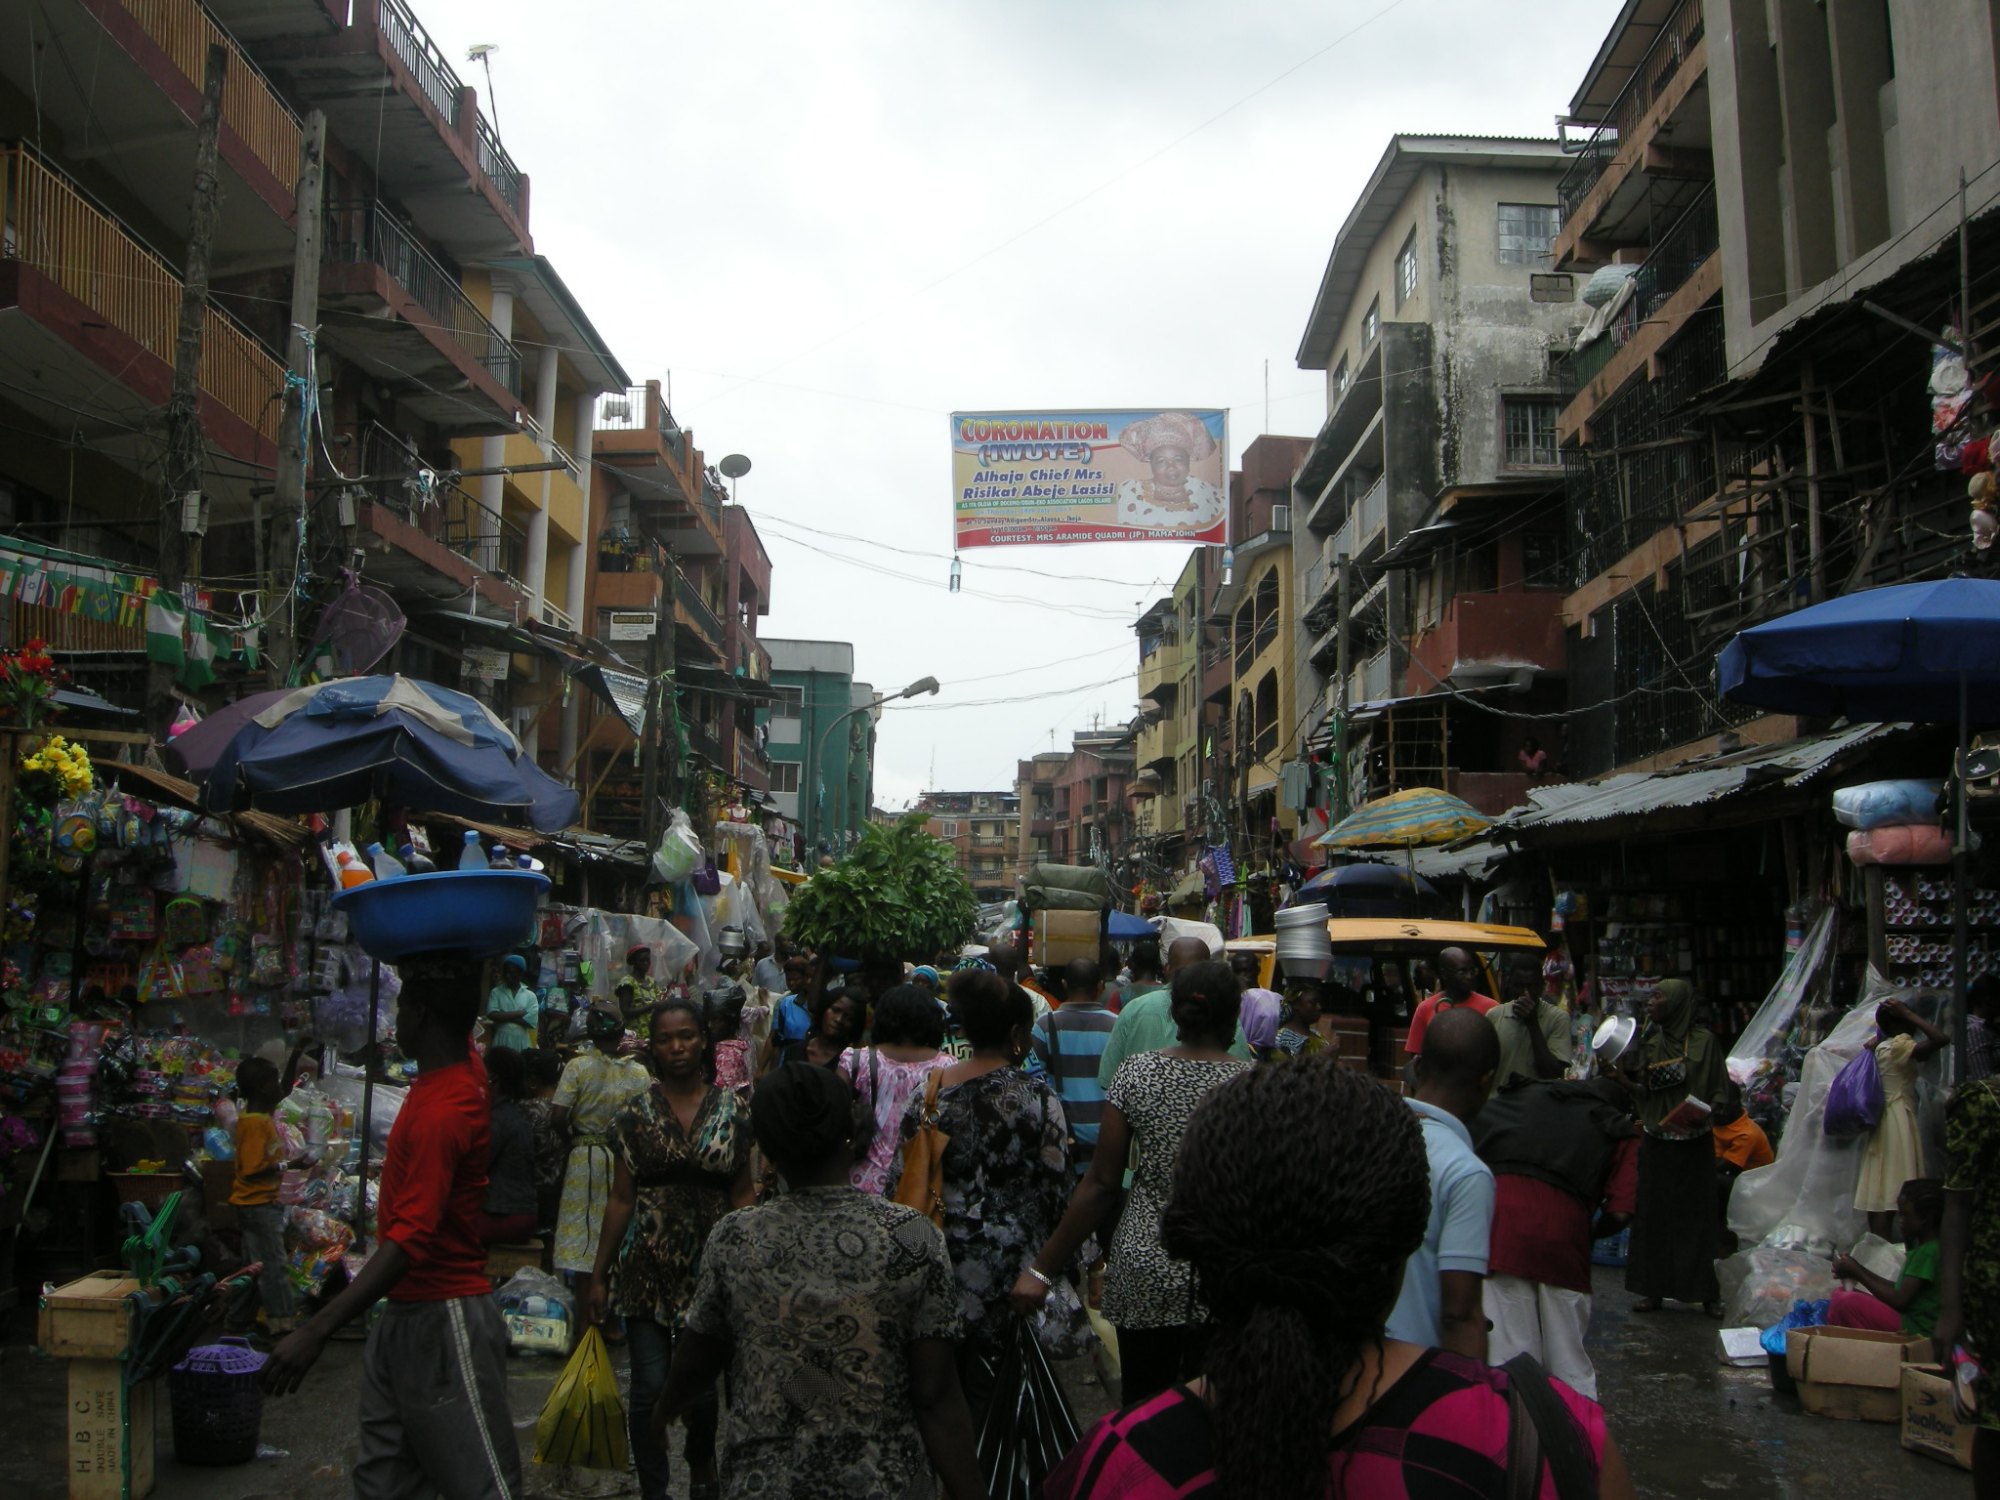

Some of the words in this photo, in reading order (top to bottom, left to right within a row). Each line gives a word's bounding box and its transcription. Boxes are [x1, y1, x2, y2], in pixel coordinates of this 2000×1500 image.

[961, 419, 1109, 442] CORONATION
[978, 442, 1093, 467] (IWUYE)
[973, 470, 1024, 485] Alhaja
[1029, 468, 1070, 481] Chief
[1074, 467, 1103, 480] Mrs
[963, 485, 1018, 499] Risikat
[1022, 484, 1066, 499] Abeje
[1071, 482, 1115, 496] Lasisi
[1056, 532, 1093, 540] ARAMIDE
[1095, 531, 1126, 540] QUADRI
[1129, 530, 1145, 539] (JP)
[1148, 529, 1173, 538] MAMA
[1175, 529, 1196, 538] JOHN
[106, 1391, 115, 1423] CHINA
[1908, 1405, 1953, 1436] Swallow
[106, 1427, 115, 1439] IN
[106, 1443, 116, 1473] MADE
